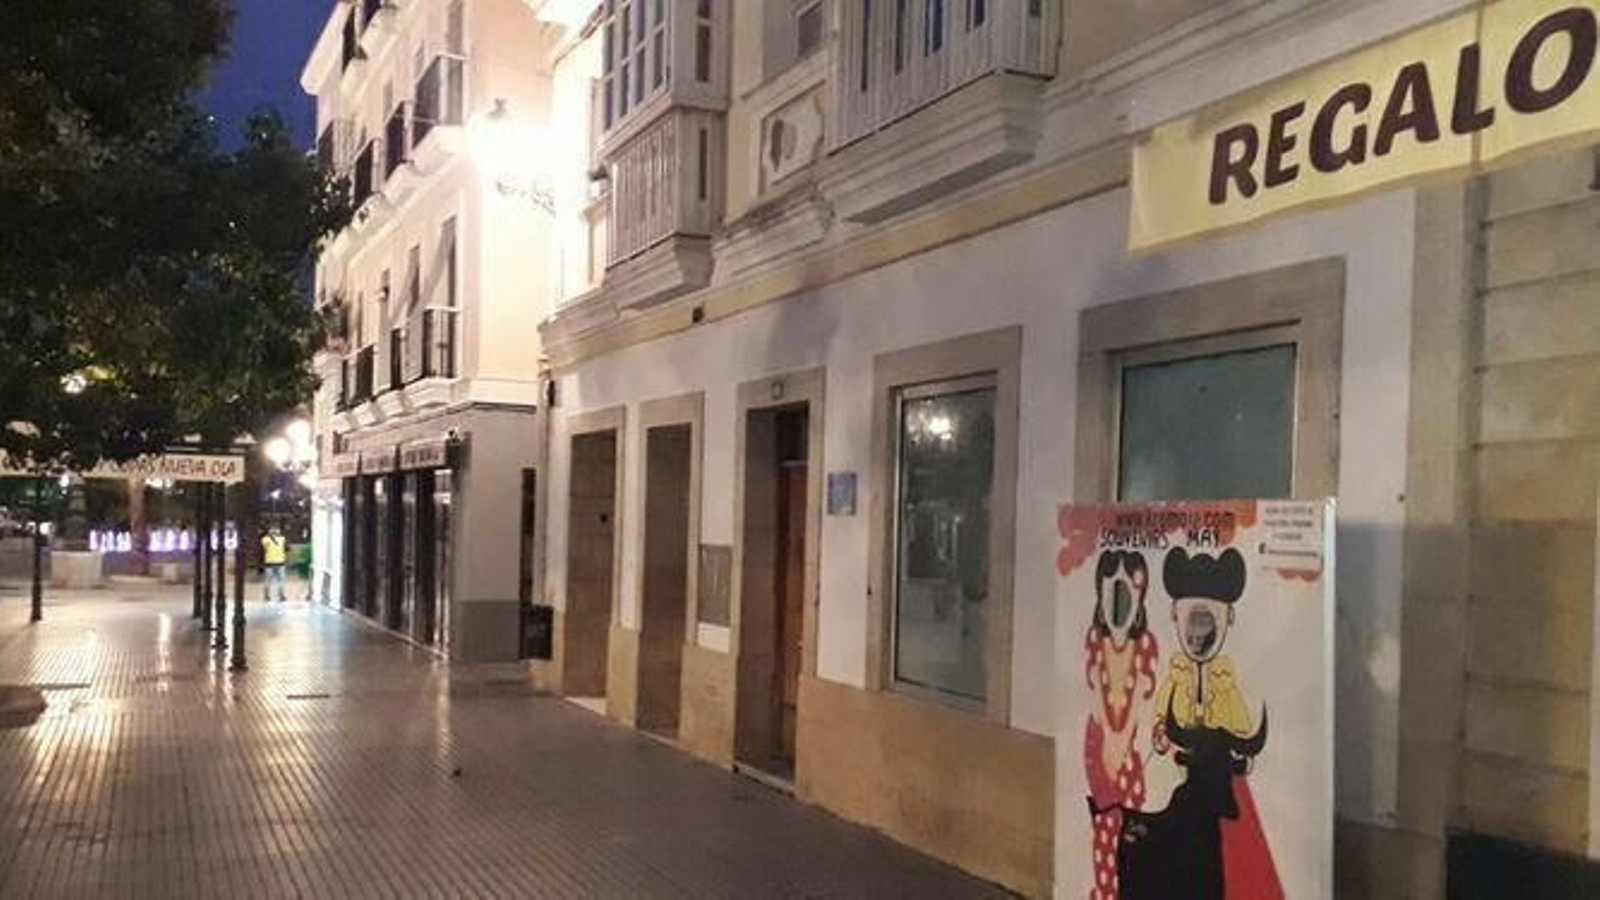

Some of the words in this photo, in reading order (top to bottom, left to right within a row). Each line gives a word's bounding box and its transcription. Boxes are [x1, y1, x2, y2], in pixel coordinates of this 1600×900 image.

[1208, 6, 1599, 206] REGALO
[159, 458, 206, 476] NUEVA
[1186, 527, 1222, 548] MAY
